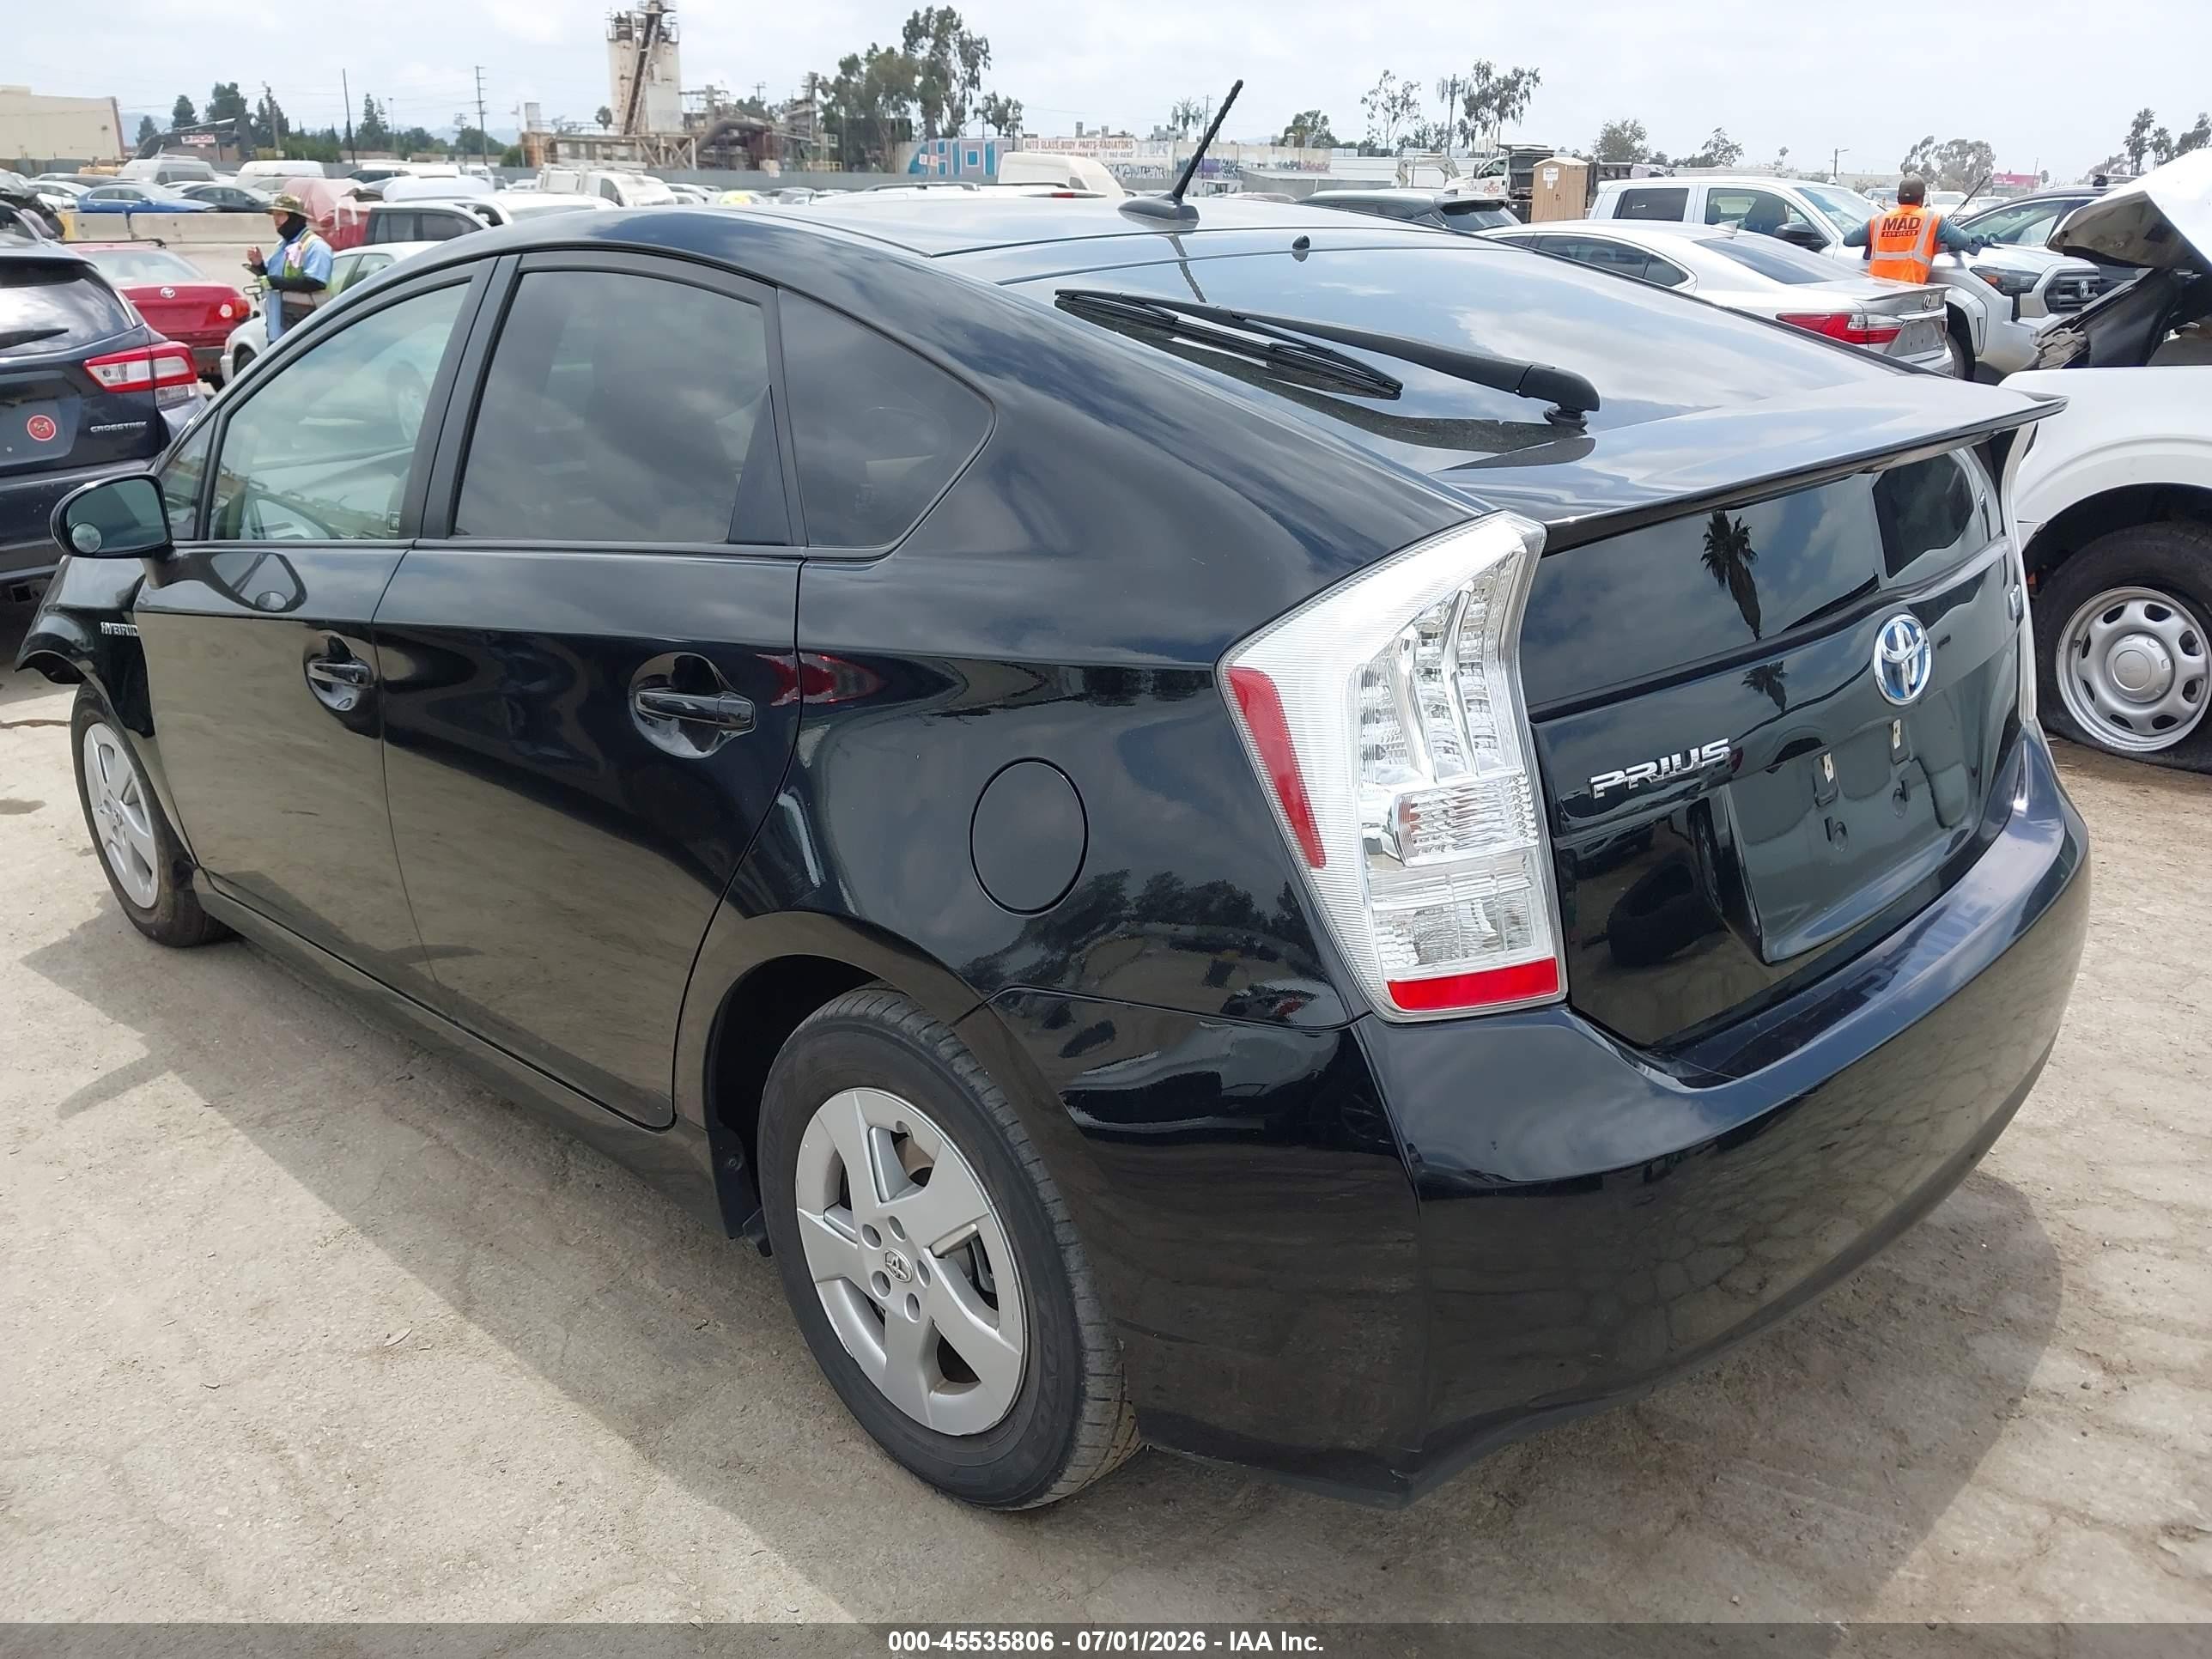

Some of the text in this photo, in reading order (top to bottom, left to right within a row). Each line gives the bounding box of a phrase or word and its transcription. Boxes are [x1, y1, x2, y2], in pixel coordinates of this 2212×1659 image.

[1882, 217, 1922, 231] MAD
[90, 421, 147, 433] CROSSTREK
[1590, 738, 1731, 799] PRIUS
